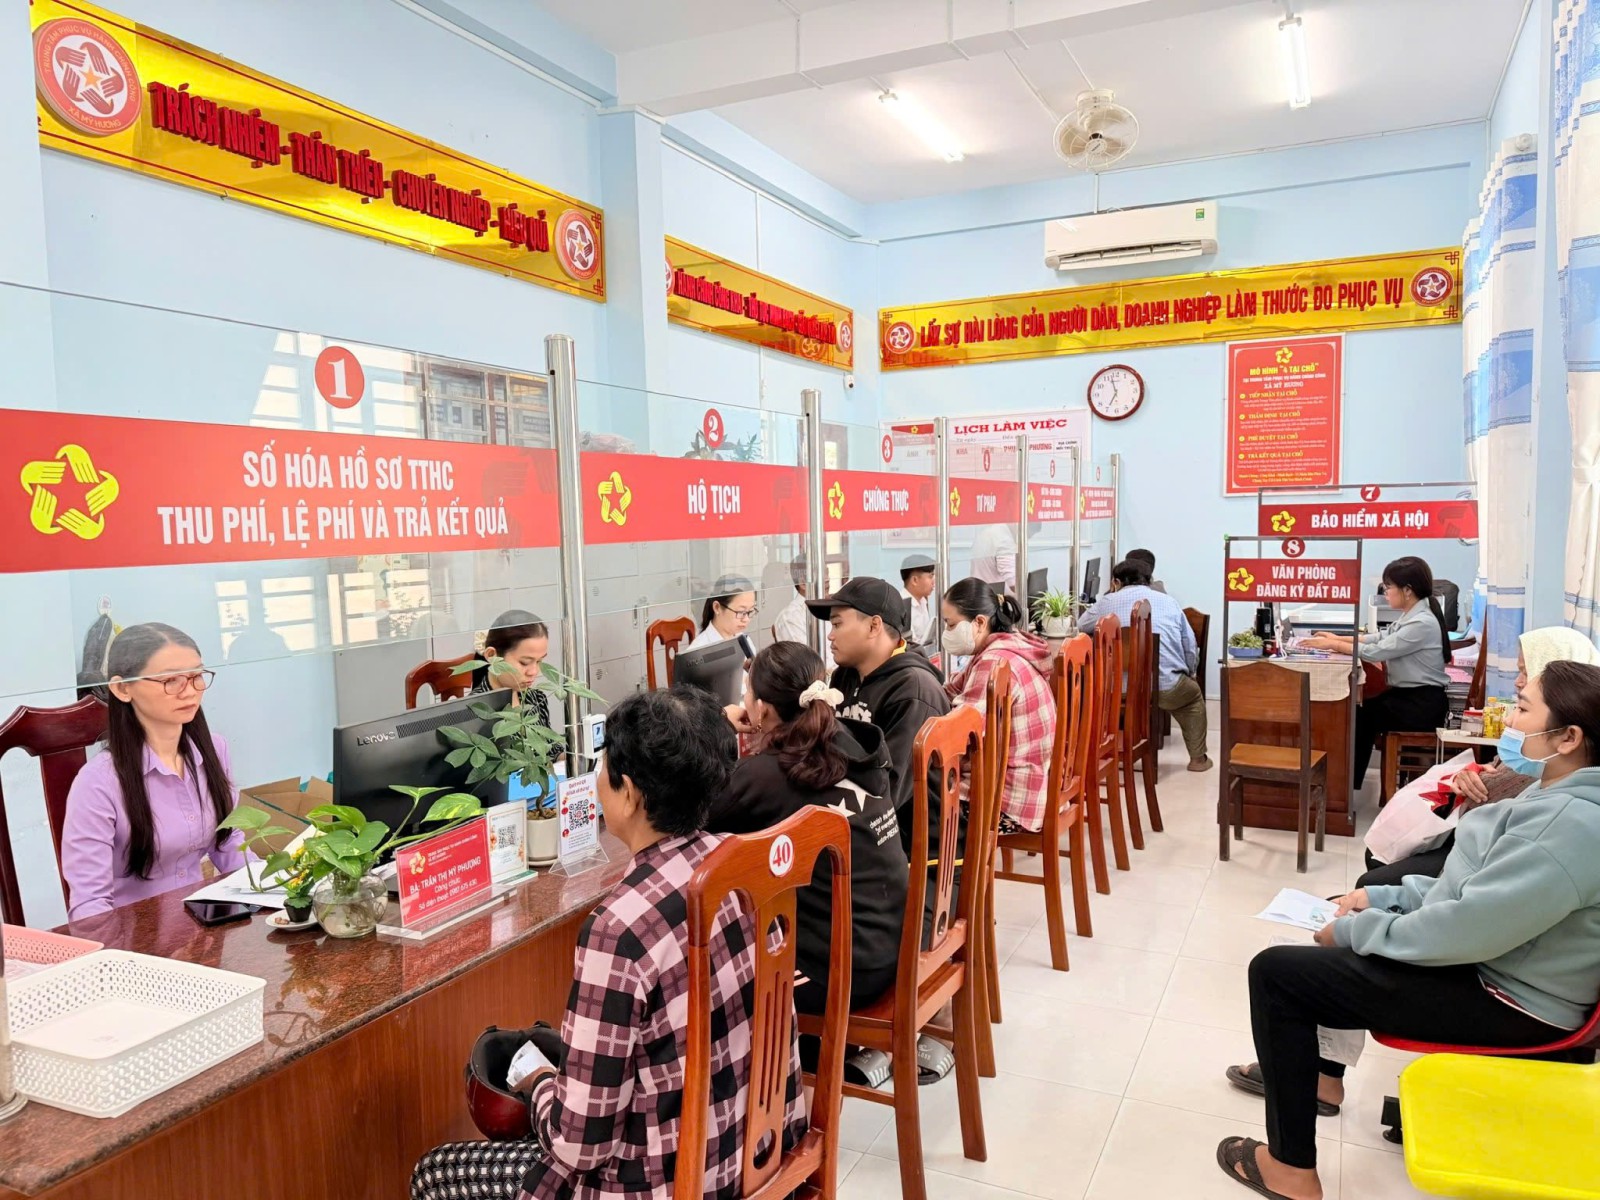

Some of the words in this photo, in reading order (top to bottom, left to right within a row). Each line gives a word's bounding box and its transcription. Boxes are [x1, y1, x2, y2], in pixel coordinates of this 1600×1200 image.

[68, 104, 81, 117] XÃ
[81, 112, 95, 125] MỸ
[95, 118, 121, 130] HƯƠNG
[147, 82, 220, 146] TRÁCH
[218, 108, 281, 168] NHIỆM
[288, 131, 338, 184] THÂN
[336, 149, 384, 204] THIỆN
[391, 169, 448, 222] CHUYÊN
[446, 188, 491, 237] NGHIỆP
[920, 317, 942, 347] LẤY
[944, 319, 961, 349] SỰ
[964, 315, 984, 344] HÀI
[987, 311, 1018, 341] LÒNG
[1021, 306, 1046, 337] CỦA
[1049, 304, 1088, 335] NGƯỜI
[1091, 301, 1121, 332] DÂN,
[1124, 300, 1170, 328] DOANH
[1173, 289, 1222, 324] NGHIỆP
[1227, 288, 1257, 319] LÀM
[1262, 282, 1308, 314] THƯỚC
[1337, 280, 1378, 312] PHỤC
[1384, 278, 1404, 308] VỤ
[328, 358, 353, 401] 1
[708, 415, 719, 442] 2
[954, 423, 992, 436] LỊCH
[993, 419, 1026, 432] LÀM
[1027, 418, 1068, 431] VIỆC
[884, 439, 890, 458] 3
[243, 440, 277, 488] SỐ
[284, 447, 333, 490] HÓA
[339, 445, 372, 490] HỒ
[376, 454, 404, 491] SƠ
[407, 459, 454, 492] TTHC
[687, 478, 707, 521] HỘ
[710, 484, 741, 521] TỊCH
[863, 485, 890, 513] CHỨNG
[891, 488, 910, 517] THỰC
[984, 491, 997, 513] PHÁP
[1365, 486, 1375, 499] 7
[157, 506, 213, 546] THU
[223, 499, 276, 549] PHÍ,
[283, 500, 311, 549] LỆ
[318, 499, 355, 541] PHÍ
[361, 500, 390, 539] VÀ
[394, 495, 432, 537] TRẢ
[436, 495, 470, 536] KẾT
[474, 496, 510, 536] QUẢ
[1311, 509, 1338, 529] BẢO
[1342, 508, 1378, 528] HIỂM
[1381, 508, 1401, 528] XÃ
[1404, 509, 1429, 530] HỘI
[1287, 539, 1300, 555] 8
[1272, 565, 1295, 580] VĂN
[1297, 565, 1337, 581] PHÒNG
[1256, 584, 1288, 599] ĐĂNG
[1290, 582, 1305, 599] KÝ
[1307, 582, 1330, 600] ĐẤT
[1331, 585, 1351, 600] ĐAI
[356, 731, 396, 747] Lenovo
[773, 841, 791, 868] 40
[421, 874, 437, 889] TRẦN
[437, 871, 448, 882] THỊ
[448, 865, 458, 878] MỸ
[457, 856, 481, 874] PHƯỢNG
[434, 883, 448, 893] Công
[418, 902, 426, 911] Số
[426, 898, 437, 909] điện
